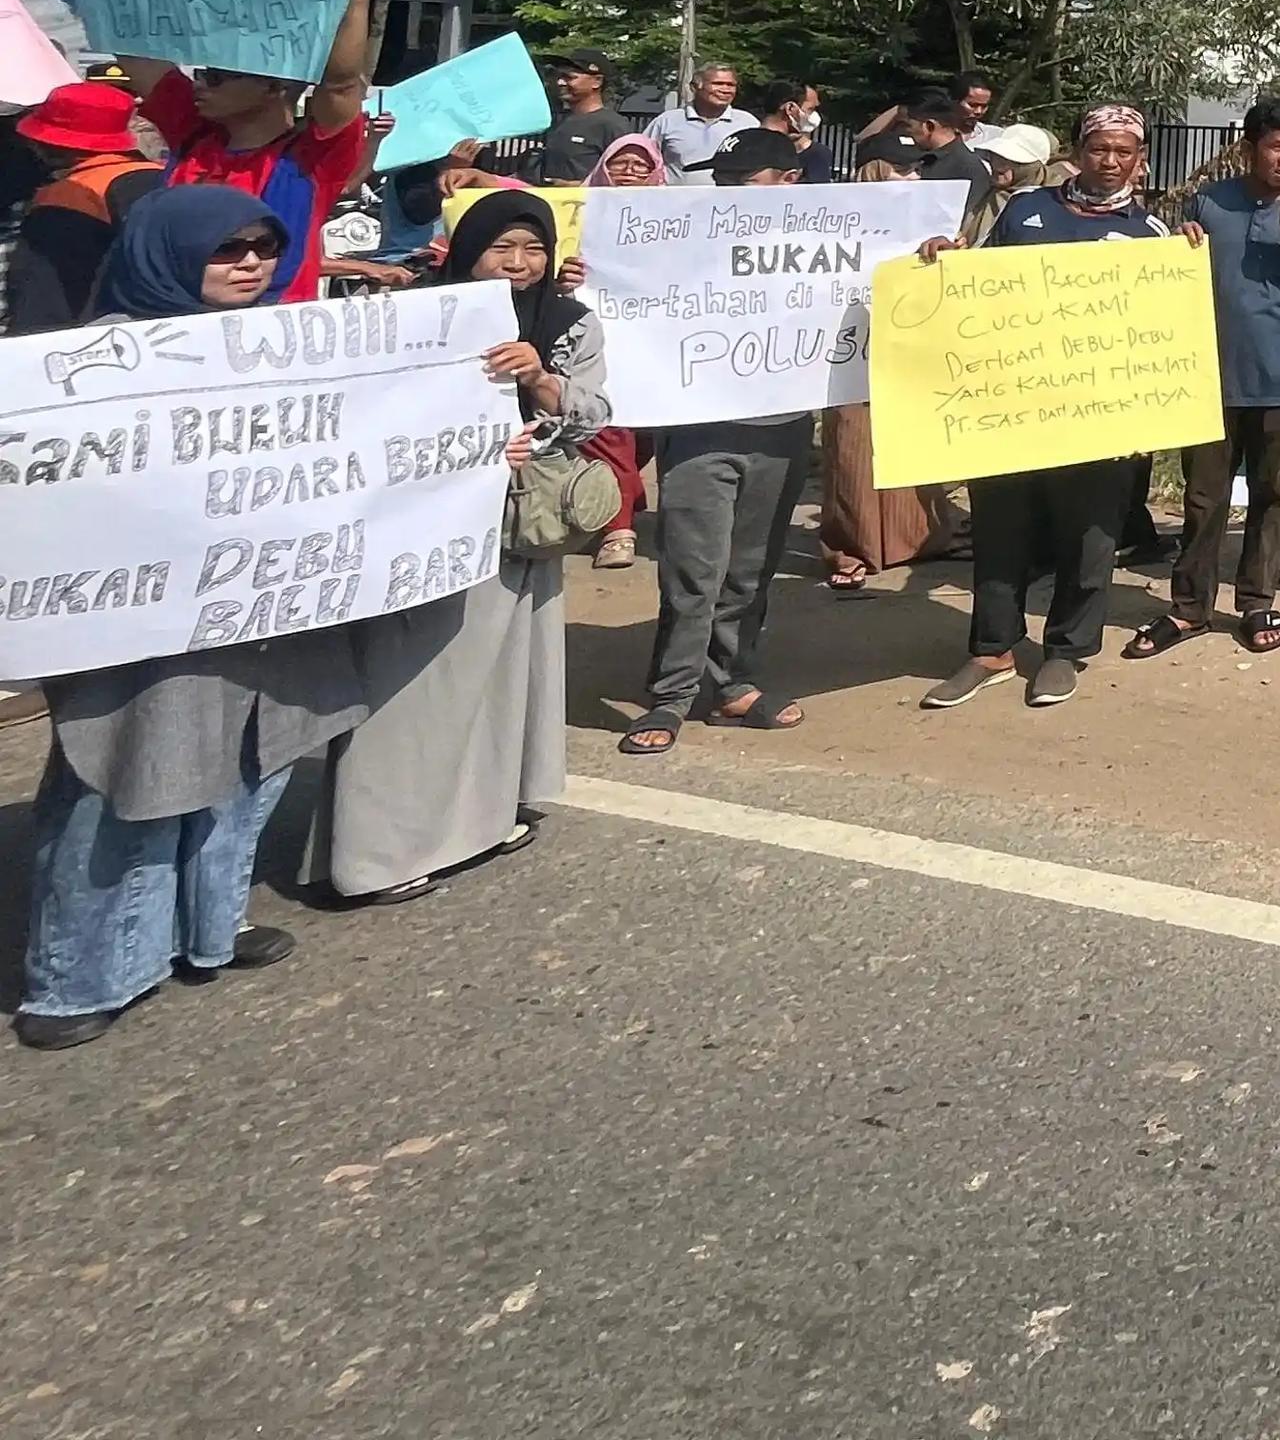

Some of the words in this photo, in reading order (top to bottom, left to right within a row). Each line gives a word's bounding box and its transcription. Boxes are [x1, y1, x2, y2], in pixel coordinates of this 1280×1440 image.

[731, 242, 863, 277] BUKAN
[599, 282, 768, 321] bertahan
[786, 281, 813, 308] di
[891, 259, 1026, 329] JANGAN
[957, 311, 1044, 339] CUCU
[680, 325, 870, 389] POLUS
[945, 342, 1044, 383] DENGAN
[1062, 327, 1175, 359] DEBU-DEBU
[933, 381, 1007, 412] YANG
[1016, 366, 1096, 394] KALIAN
[205, 451, 367, 519] UDARA
[0, 560, 171, 622] UKAN
[195, 518, 365, 598] DEBU
